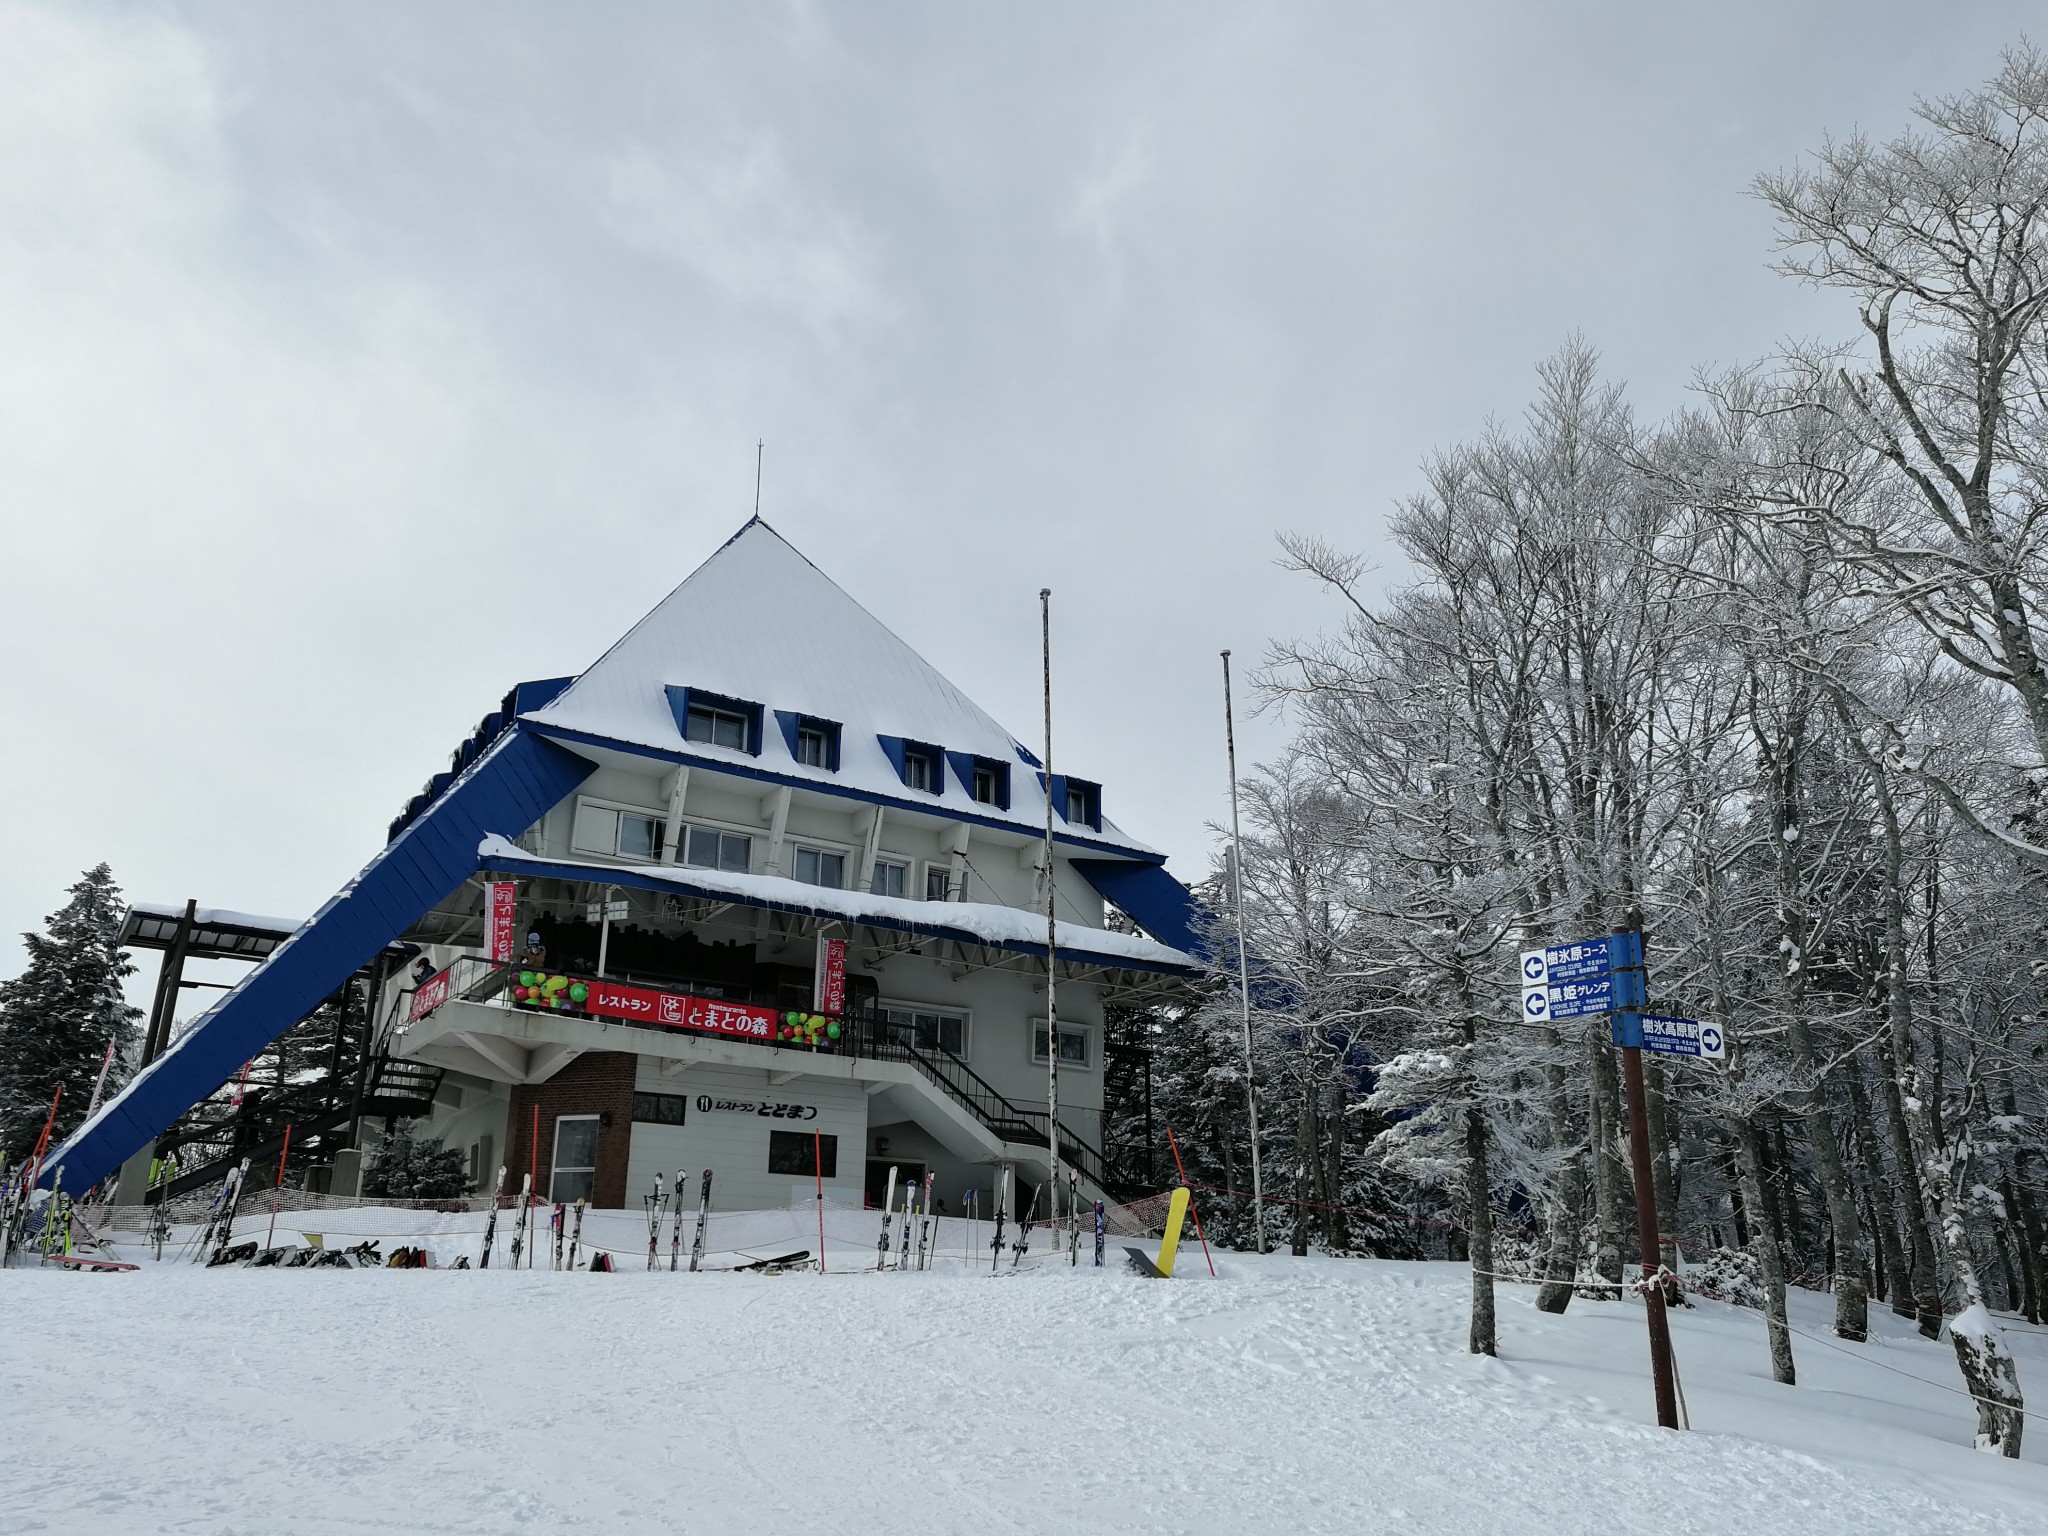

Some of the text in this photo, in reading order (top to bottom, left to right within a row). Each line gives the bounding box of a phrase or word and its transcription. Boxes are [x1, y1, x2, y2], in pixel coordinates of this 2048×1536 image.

[1547, 944, 1608, 965] 樹氷原コース
[598, 993, 652, 1013] レストラン
[1549, 982, 1610, 1003] 黒姫ゲレンデ
[708, 1003, 747, 1015] Restaurants
[689, 1008, 768, 1035] とまとの森
[1642, 1018, 1699, 1039] 樹氷高原駅
[715, 1100, 817, 1120] レストラン とどまつ
